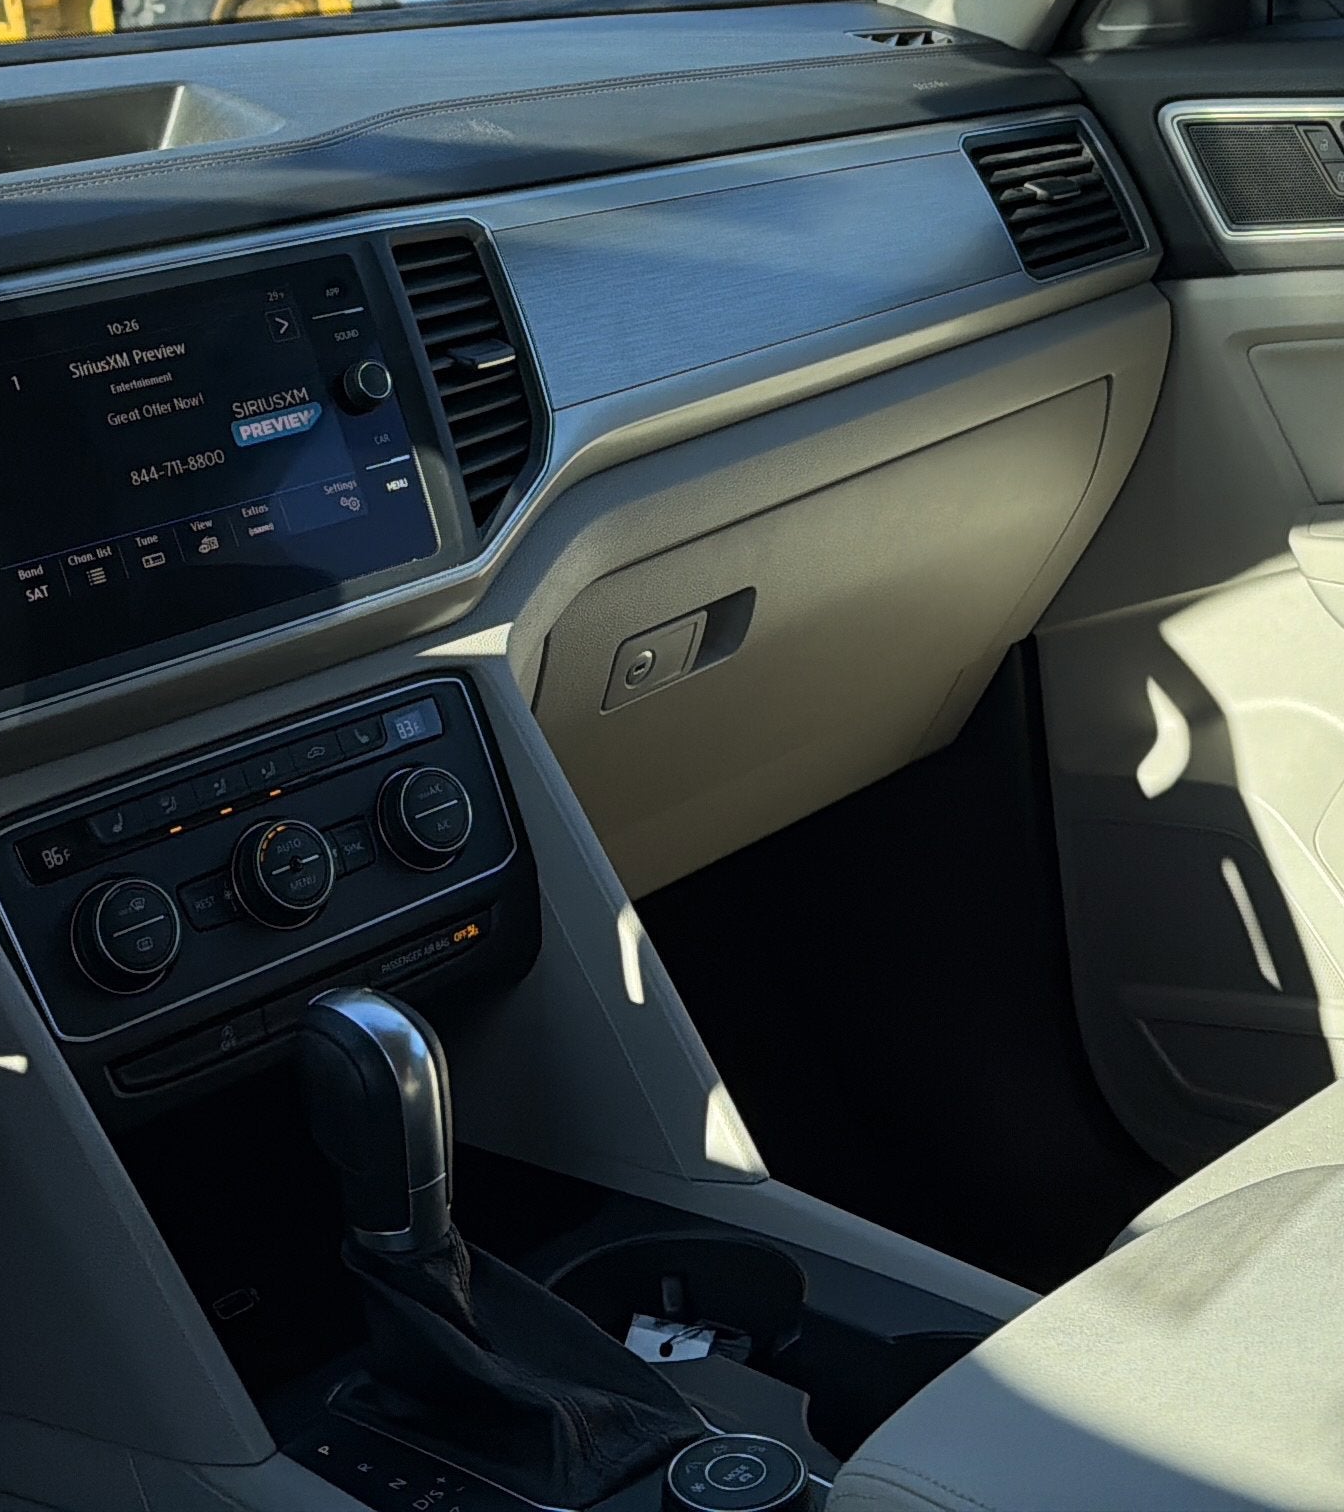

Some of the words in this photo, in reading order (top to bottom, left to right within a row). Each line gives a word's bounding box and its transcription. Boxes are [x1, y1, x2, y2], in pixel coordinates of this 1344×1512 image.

[107, 319, 139, 336] 10:26
[334, 329, 359, 342] SOUND
[69, 351, 130, 379] SiriusXM
[132, 343, 186, 365] Preview
[110, 372, 173, 395] Entertainment
[107, 407, 141, 426] Great
[142, 402, 172, 418] Offer
[173, 392, 205, 411] Now!
[232, 387, 310, 419] SIRIUSXM
[374, 434, 391, 445] CAR
[130, 449, 226, 486] 844-711-8800
[324, 479, 358, 496] Settings
[386, 478, 408, 493] MENU
[241, 503, 269, 518] Extras
[190, 519, 213, 532] View
[135, 534, 159, 548] Tune
[68, 549, 96, 567] Chan.
[96, 546, 113, 558] list
[18, 565, 44, 580] Band
[26, 585, 49, 602] SAT
[277, 838, 302, 854] AUTO
[317, 1445, 330, 1456] P
[357, 1463, 373, 1473] R
[388, 1478, 408, 1490] N
[412, 1489, 445, 1511] D/S
